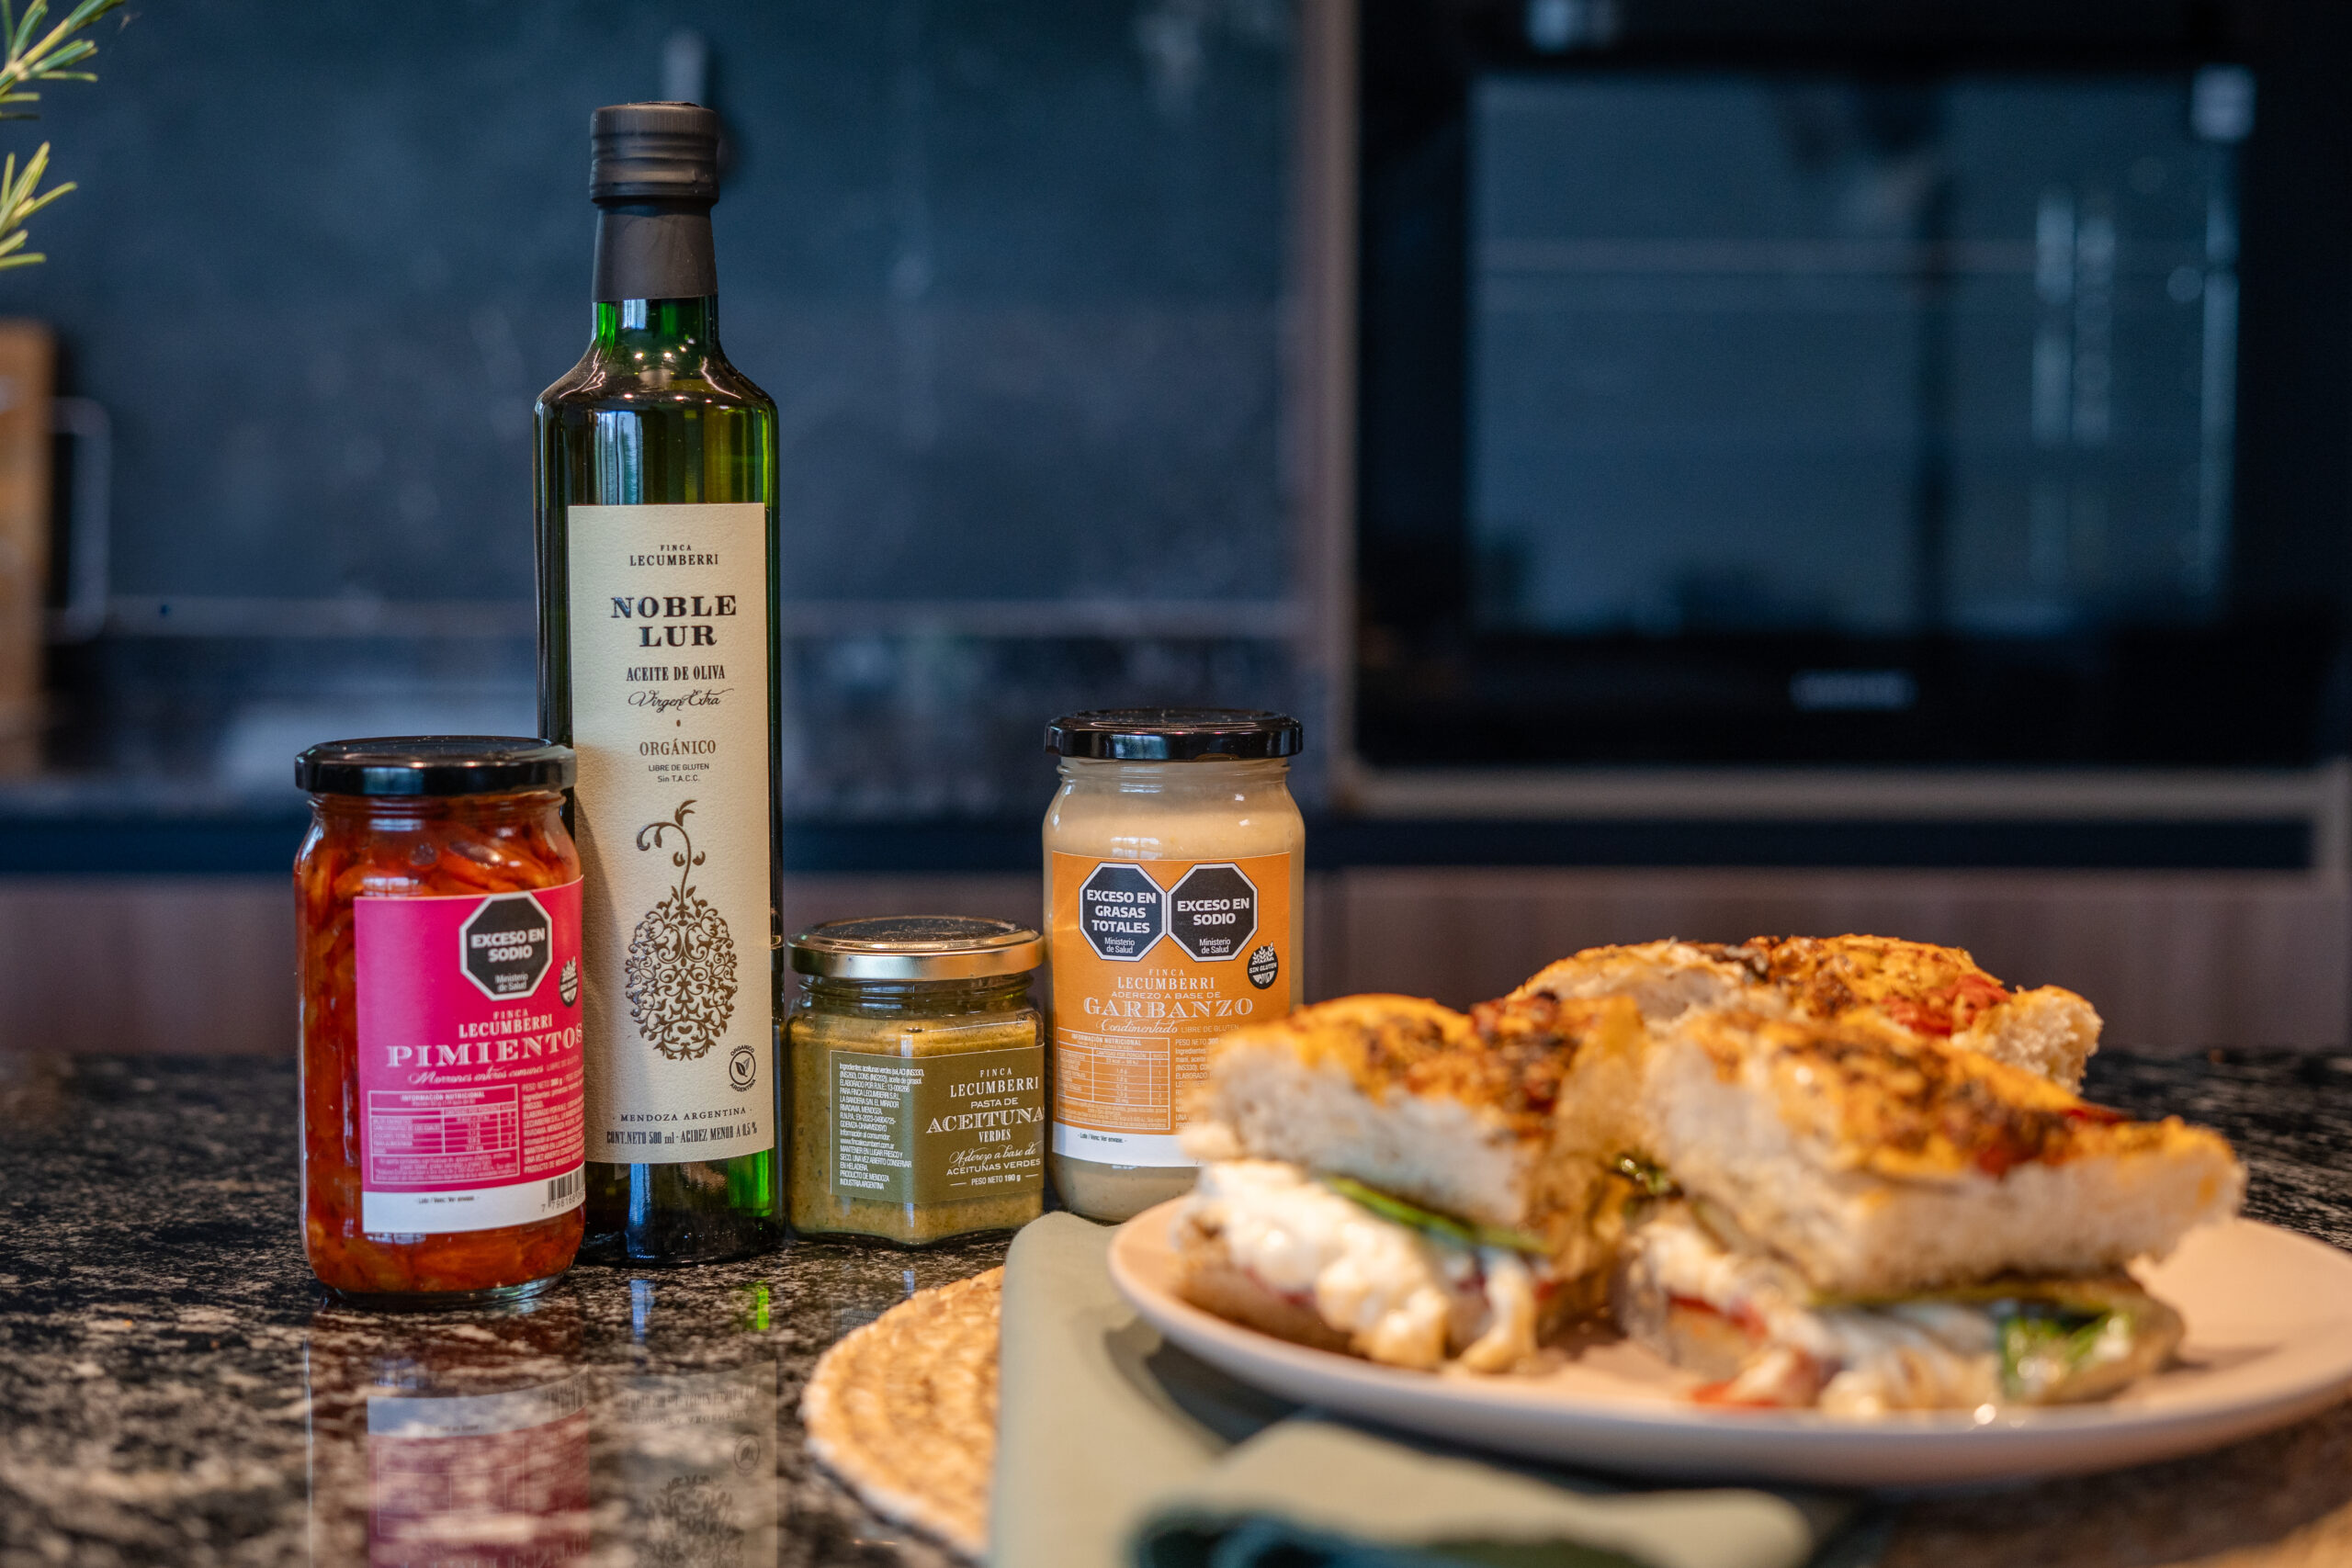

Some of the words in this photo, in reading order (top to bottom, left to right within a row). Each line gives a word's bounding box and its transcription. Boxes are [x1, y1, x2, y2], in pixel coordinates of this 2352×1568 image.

[629, 554, 718, 567] LECUMBERRI
[610, 594, 737, 618] NOBLE
[639, 625, 718, 649] LUR
[626, 666, 669, 682] ACEITE
[673, 666, 689, 681] DE
[693, 664, 725, 680] OLIVA
[628, 690, 684, 713] Virgen
[682, 688, 735, 706] Extra
[639, 738, 717, 756] ORGÁNICO
[682, 762, 710, 771] GLUTEN
[673, 773, 700, 783] T.A.C.C.
[1087, 889, 1135, 903] EXCESO
[1136, 892, 1157, 904] EN
[1177, 898, 1229, 912] EXCESO
[1232, 897, 1250, 909] EN
[1095, 905, 1147, 919] GRASAS
[1193, 912, 1237, 926] SODIO
[1091, 919, 1150, 933] TOTALES
[470, 931, 527, 949] EXCESO
[527, 928, 546, 942] EN
[1104, 937, 1136, 946] Ministerio
[1199, 938, 1231, 947] Ministerio
[488, 944, 533, 963] SODIO
[1114, 946, 1134, 954] Salud
[1201, 946, 1209, 954] de
[1210, 945, 1229, 954] Salud
[1259, 963, 1277, 972] GLUTEN
[495, 972, 528, 985] Ministerio
[1117, 976, 1215, 990] LECUMBERRI
[1112, 991, 1161, 999] ADEREZO
[492, 1008, 528, 1021] FINCA
[1083, 998, 1253, 1019] GARBANZO
[458, 1014, 553, 1039] LECUMBERRI
[1096, 1018, 1193, 1034] Condimentado
[1203, 1025, 1213, 1033] DE
[386, 1022, 582, 1068] PIMIENTOS
[1104, 1036, 1142, 1046] NUTRICIONAL
[979, 1067, 1012, 1077] FINCA
[729, 1078, 756, 1092] ARGENTINA
[950, 1076, 1039, 1098] LECUMBERRI
[970, 1099, 1002, 1110] PASTA
[1004, 1097, 1019, 1106] DE
[620, 1113, 678, 1122] MENDOZA
[684, 1107, 746, 1121] ARGENTINA
[926, 1106, 1045, 1134] ACEITUNA
[649, 1131, 662, 1145] 500
[664, 1134, 675, 1144] ml
[681, 1129, 708, 1144] ACIDEZ
[710, 1125, 734, 1142] MENOR
[736, 1125, 741, 1138] A
[978, 1128, 1011, 1143] VERDES
[994, 1151, 1001, 1159] a
[999, 1145, 1023, 1157] base
[1024, 1140, 1042, 1156] de
[946, 1162, 1001, 1176] ACEITUNAS
[1003, 1158, 1041, 1169] VERDES
[971, 1177, 987, 1186] PESO
[988, 1175, 1003, 1184] NETO
[1016, 1174, 1021, 1183] g
